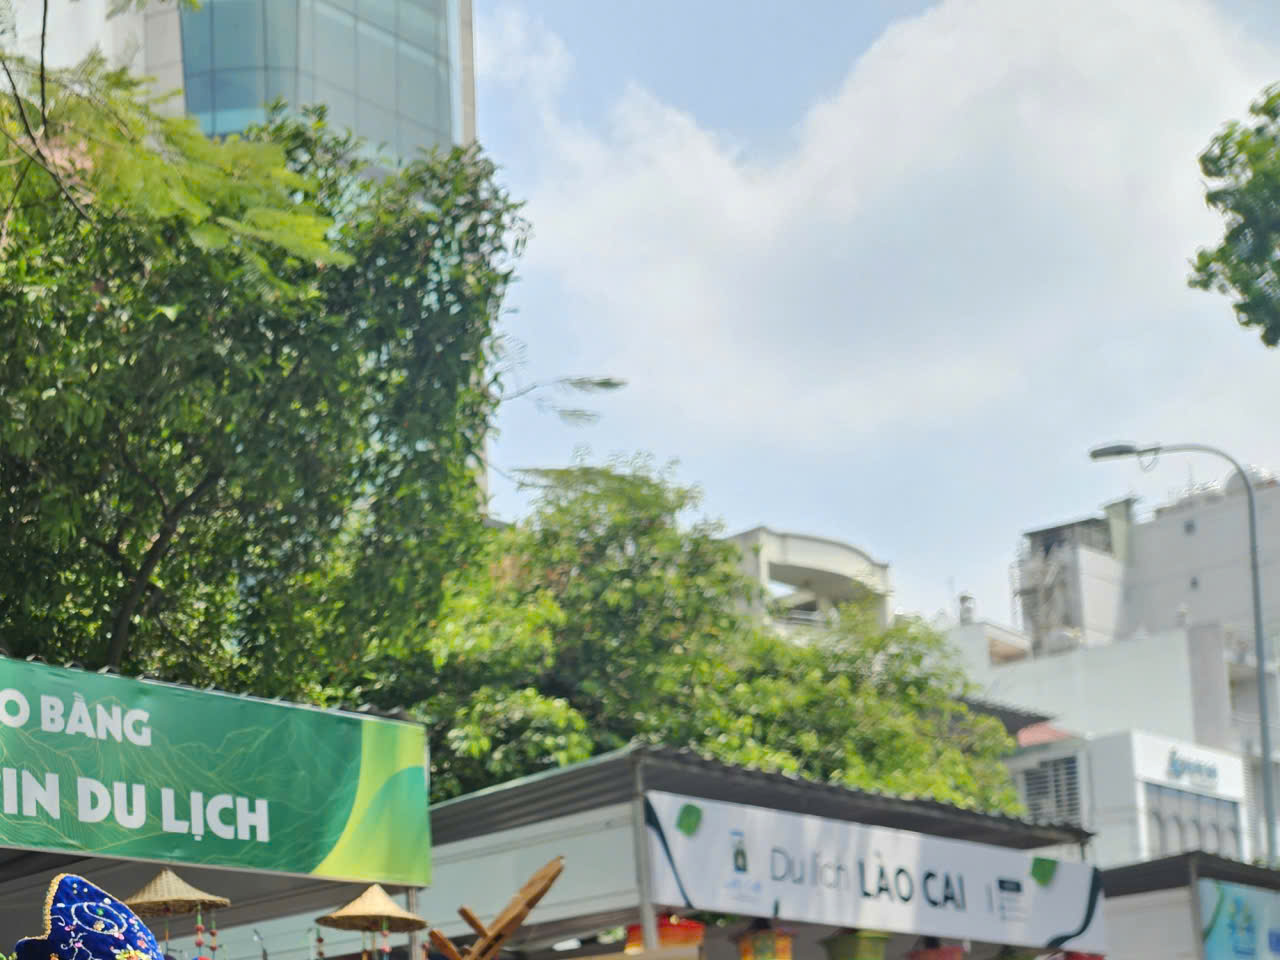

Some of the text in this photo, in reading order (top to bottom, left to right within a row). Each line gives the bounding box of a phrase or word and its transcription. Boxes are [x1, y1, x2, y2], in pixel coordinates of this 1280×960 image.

[40, 692, 152, 747] BẰNG
[77, 776, 147, 830] DU
[161, 787, 270, 842] LỊCH
[857, 851, 915, 903] LÀO
[923, 871, 967, 912] CAI
